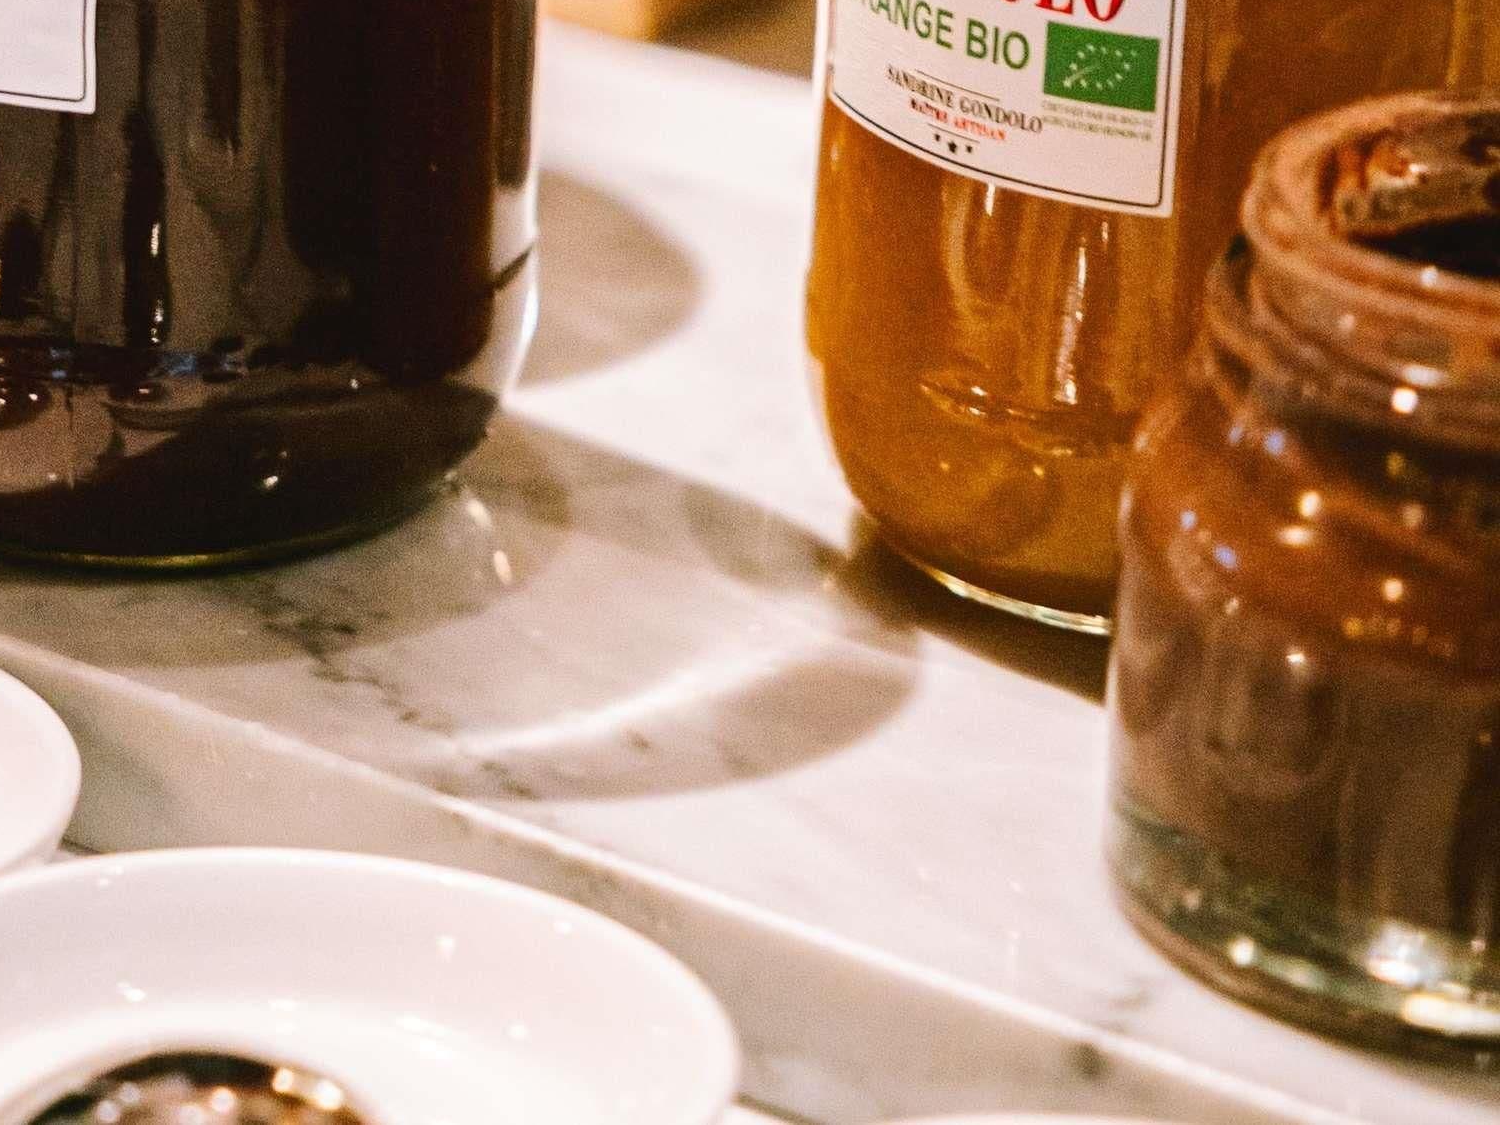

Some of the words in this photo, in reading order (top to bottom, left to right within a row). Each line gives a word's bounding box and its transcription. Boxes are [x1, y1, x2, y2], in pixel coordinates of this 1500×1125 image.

[966, 20, 1031, 71] BIO
[886, 64, 954, 108] SANDRINE
[959, 96, 1043, 133] GONDOLO
